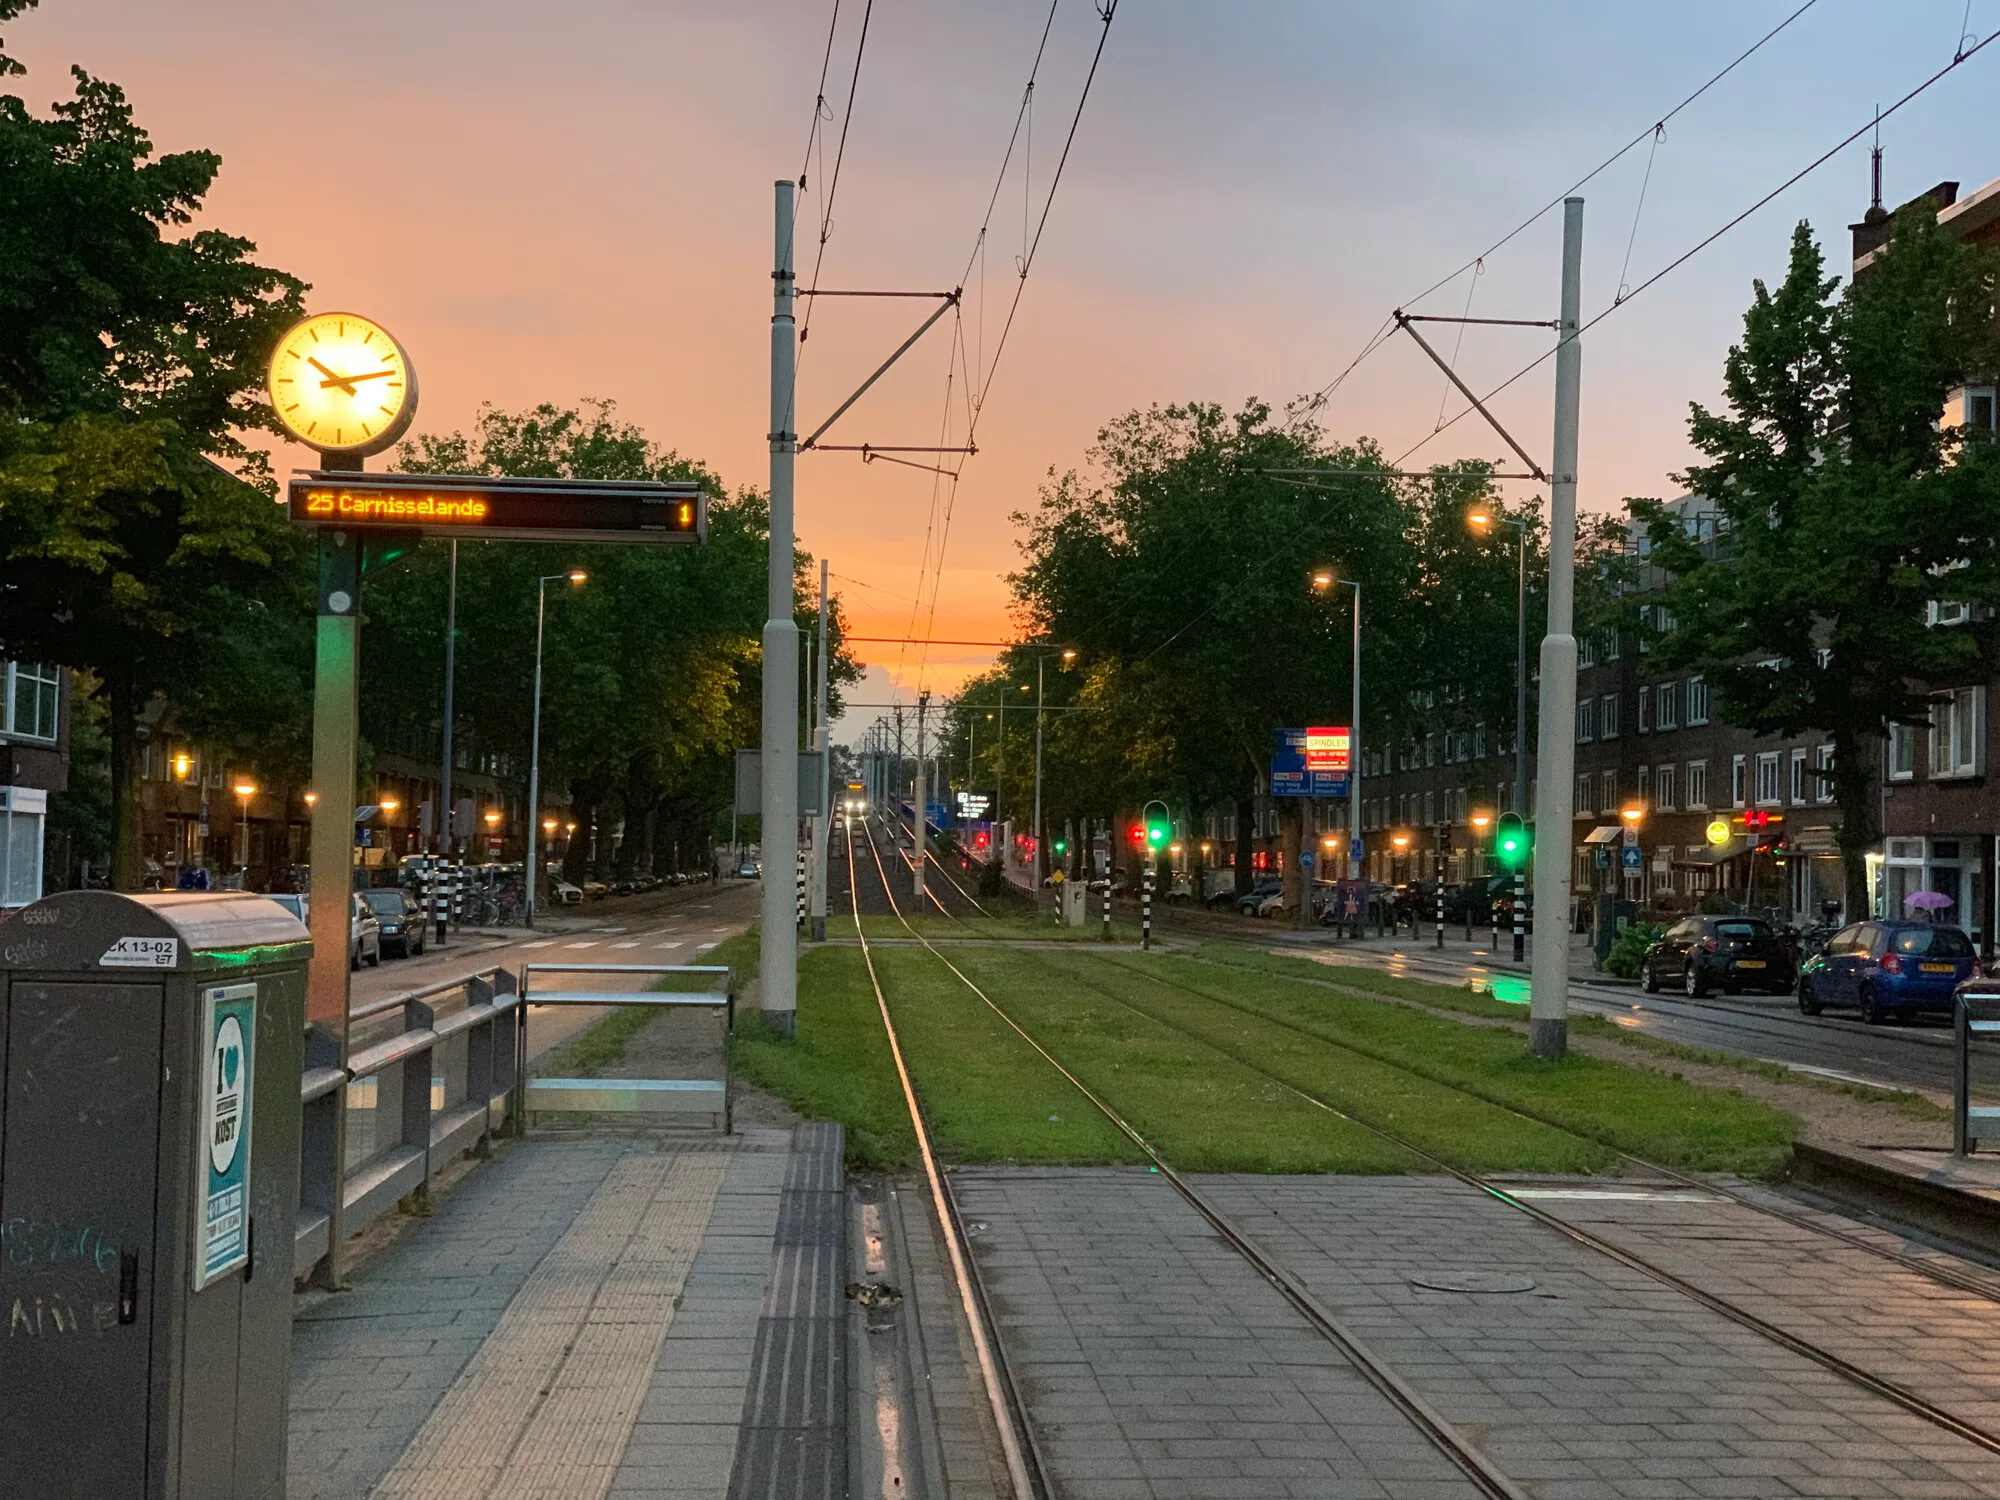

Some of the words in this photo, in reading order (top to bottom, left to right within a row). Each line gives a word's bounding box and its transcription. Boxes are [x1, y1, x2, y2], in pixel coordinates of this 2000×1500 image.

[307, 494, 334, 511] 25
[339, 495, 486, 516] Carnisselande
[680, 505, 690, 522] 1
[1308, 739, 1347, 747] SPINDLER
[132, 942, 172, 953] 13-02
[215, 1115, 237, 1146] KOST
